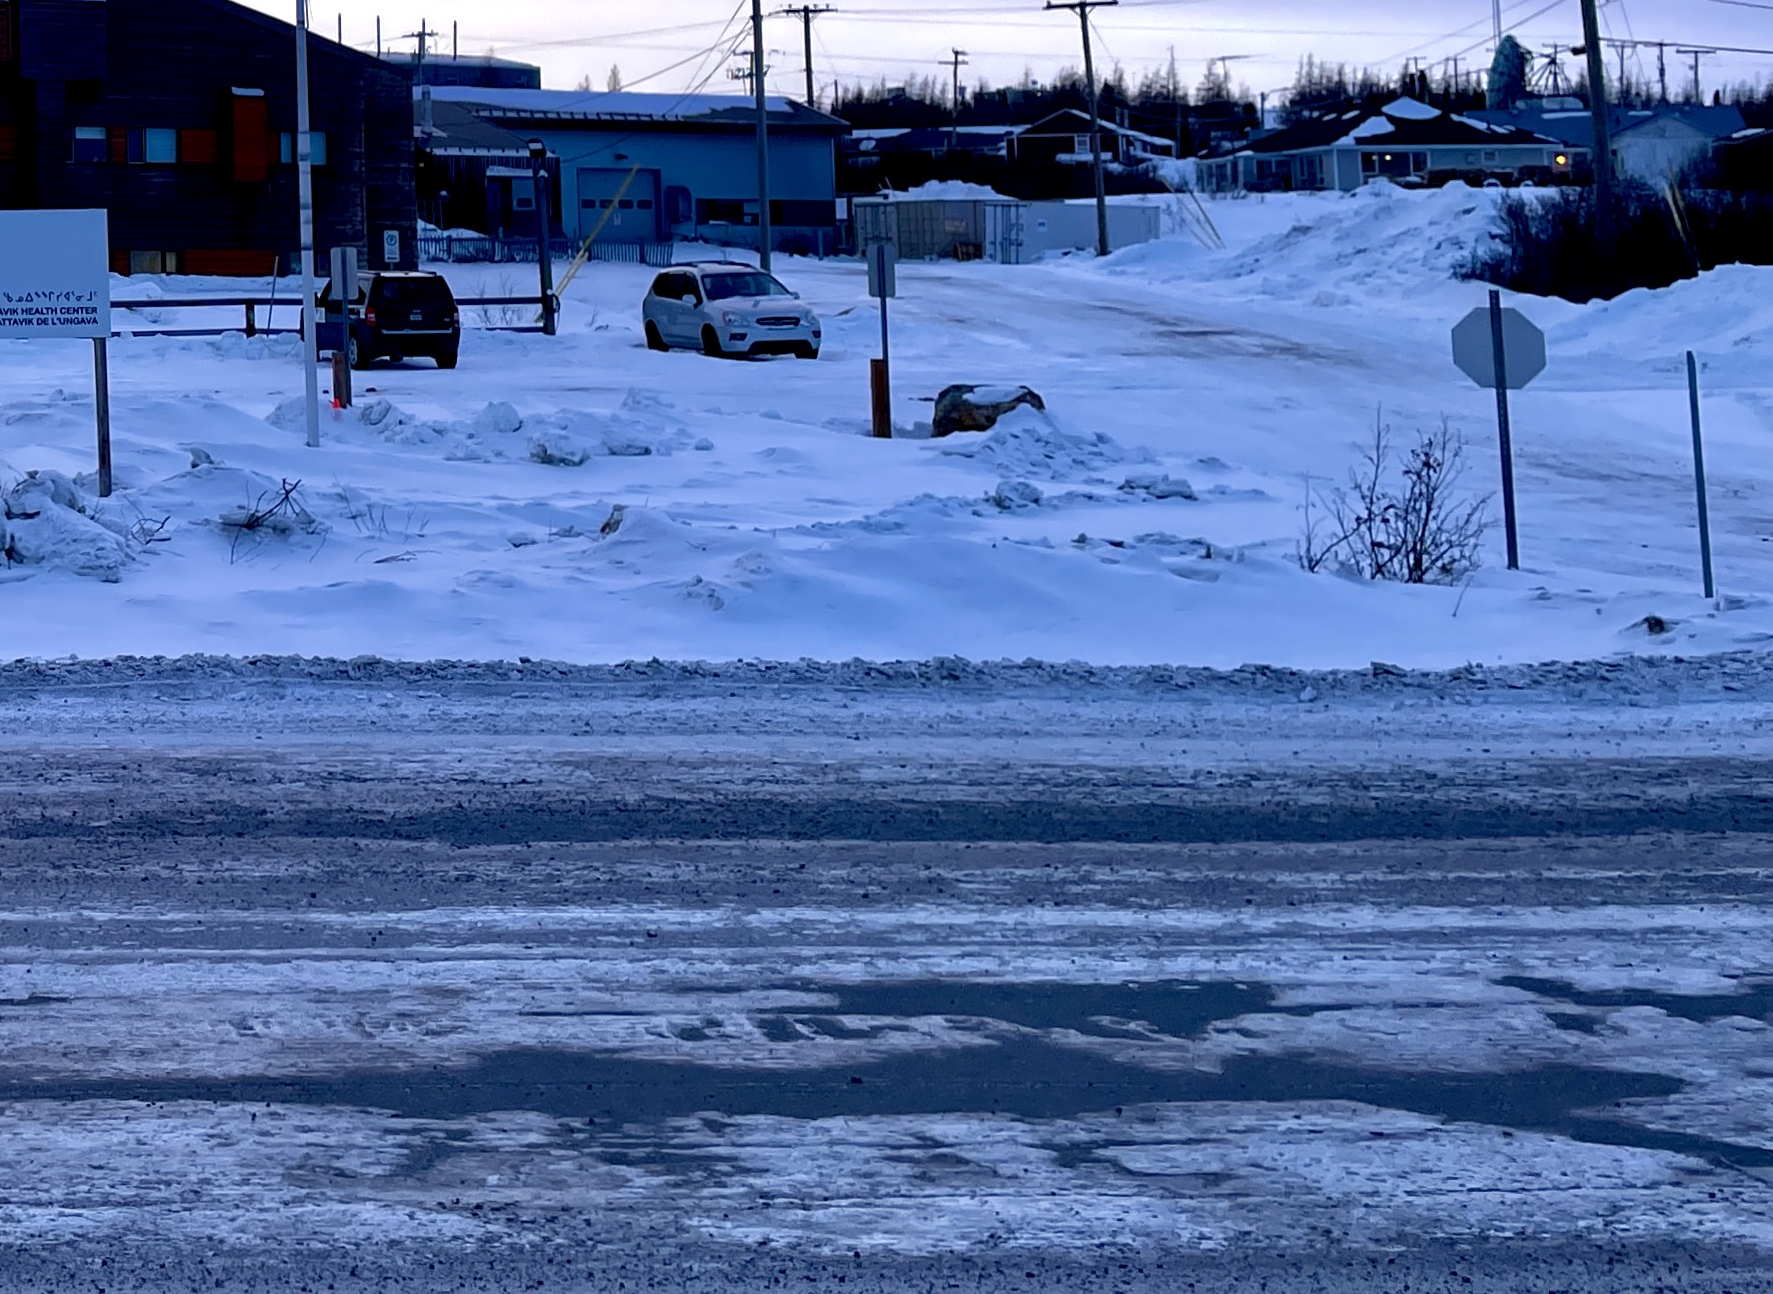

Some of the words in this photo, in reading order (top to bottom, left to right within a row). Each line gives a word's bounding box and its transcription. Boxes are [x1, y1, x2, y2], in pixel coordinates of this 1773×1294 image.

[21, 306, 58, 315] HEALTH
[59, 306, 98, 315] CENTER
[36, 317, 50, 326] DE
[51, 316, 99, 325] L'UNGAVA
